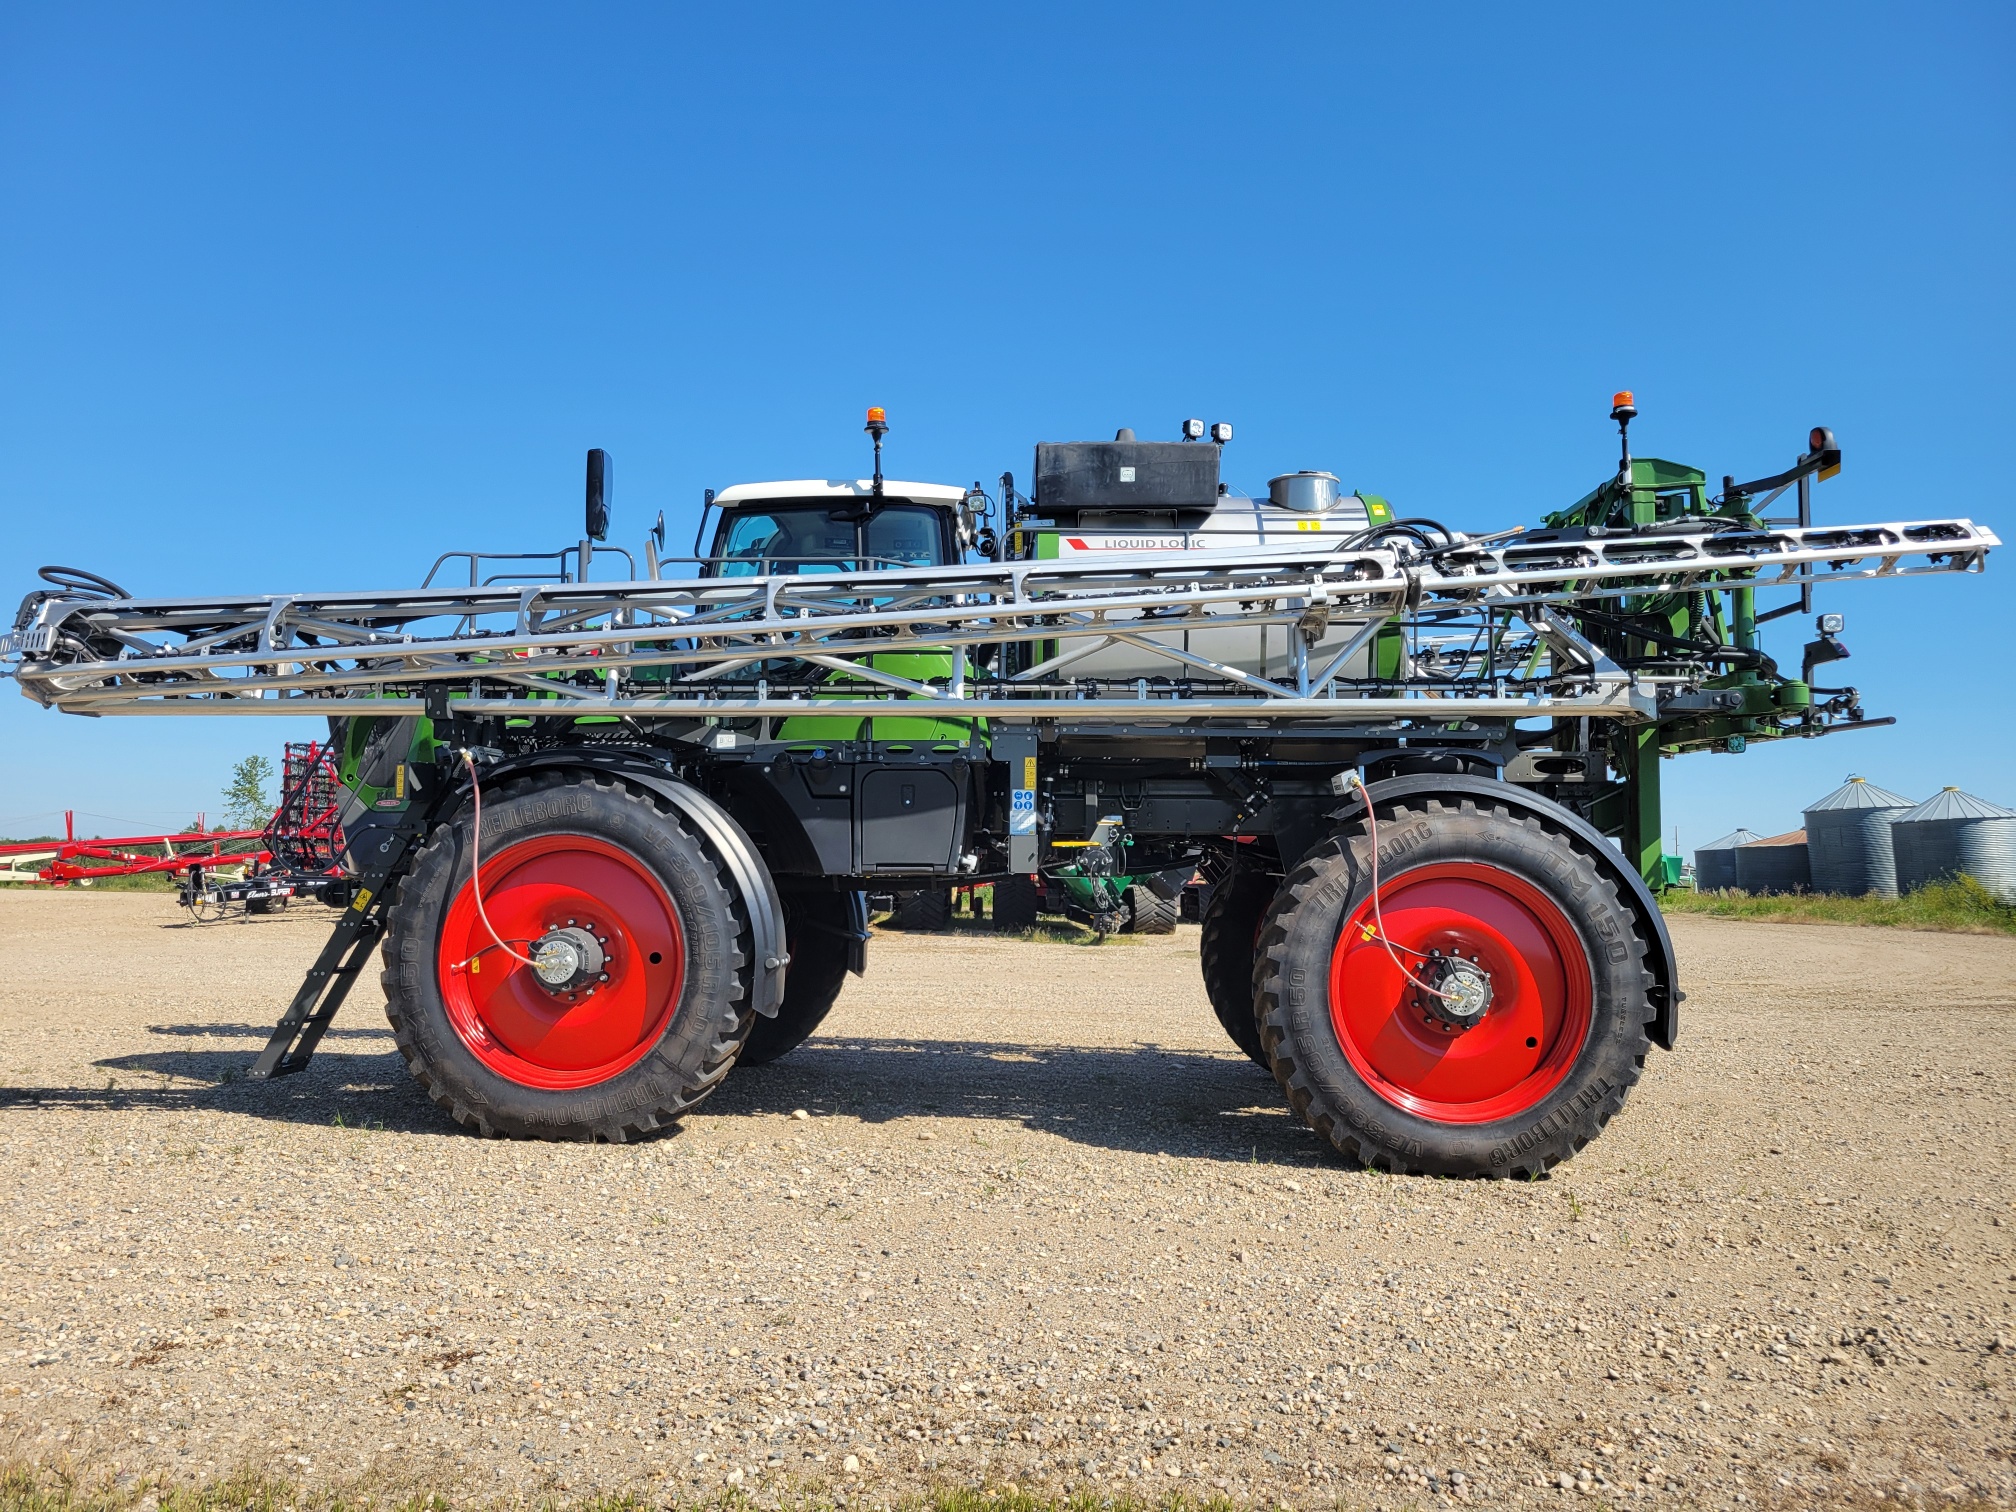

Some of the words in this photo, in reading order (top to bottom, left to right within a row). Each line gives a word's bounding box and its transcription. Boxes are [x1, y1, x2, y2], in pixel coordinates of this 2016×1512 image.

[1104, 539, 1156, 549] LIQUID
[461, 793, 592, 845] TRELLEBORG
[1307, 821, 1433, 912] TRELEBORG
[1537, 851, 1593, 903] TM
[1586, 903, 1629, 966] 150
[400, 937, 423, 1001] 150
[406, 1007, 444, 1064] TM
[523, 1080, 667, 1128] TRELLEBORG
[1488, 1076, 1616, 1167] TRELLEBORG
